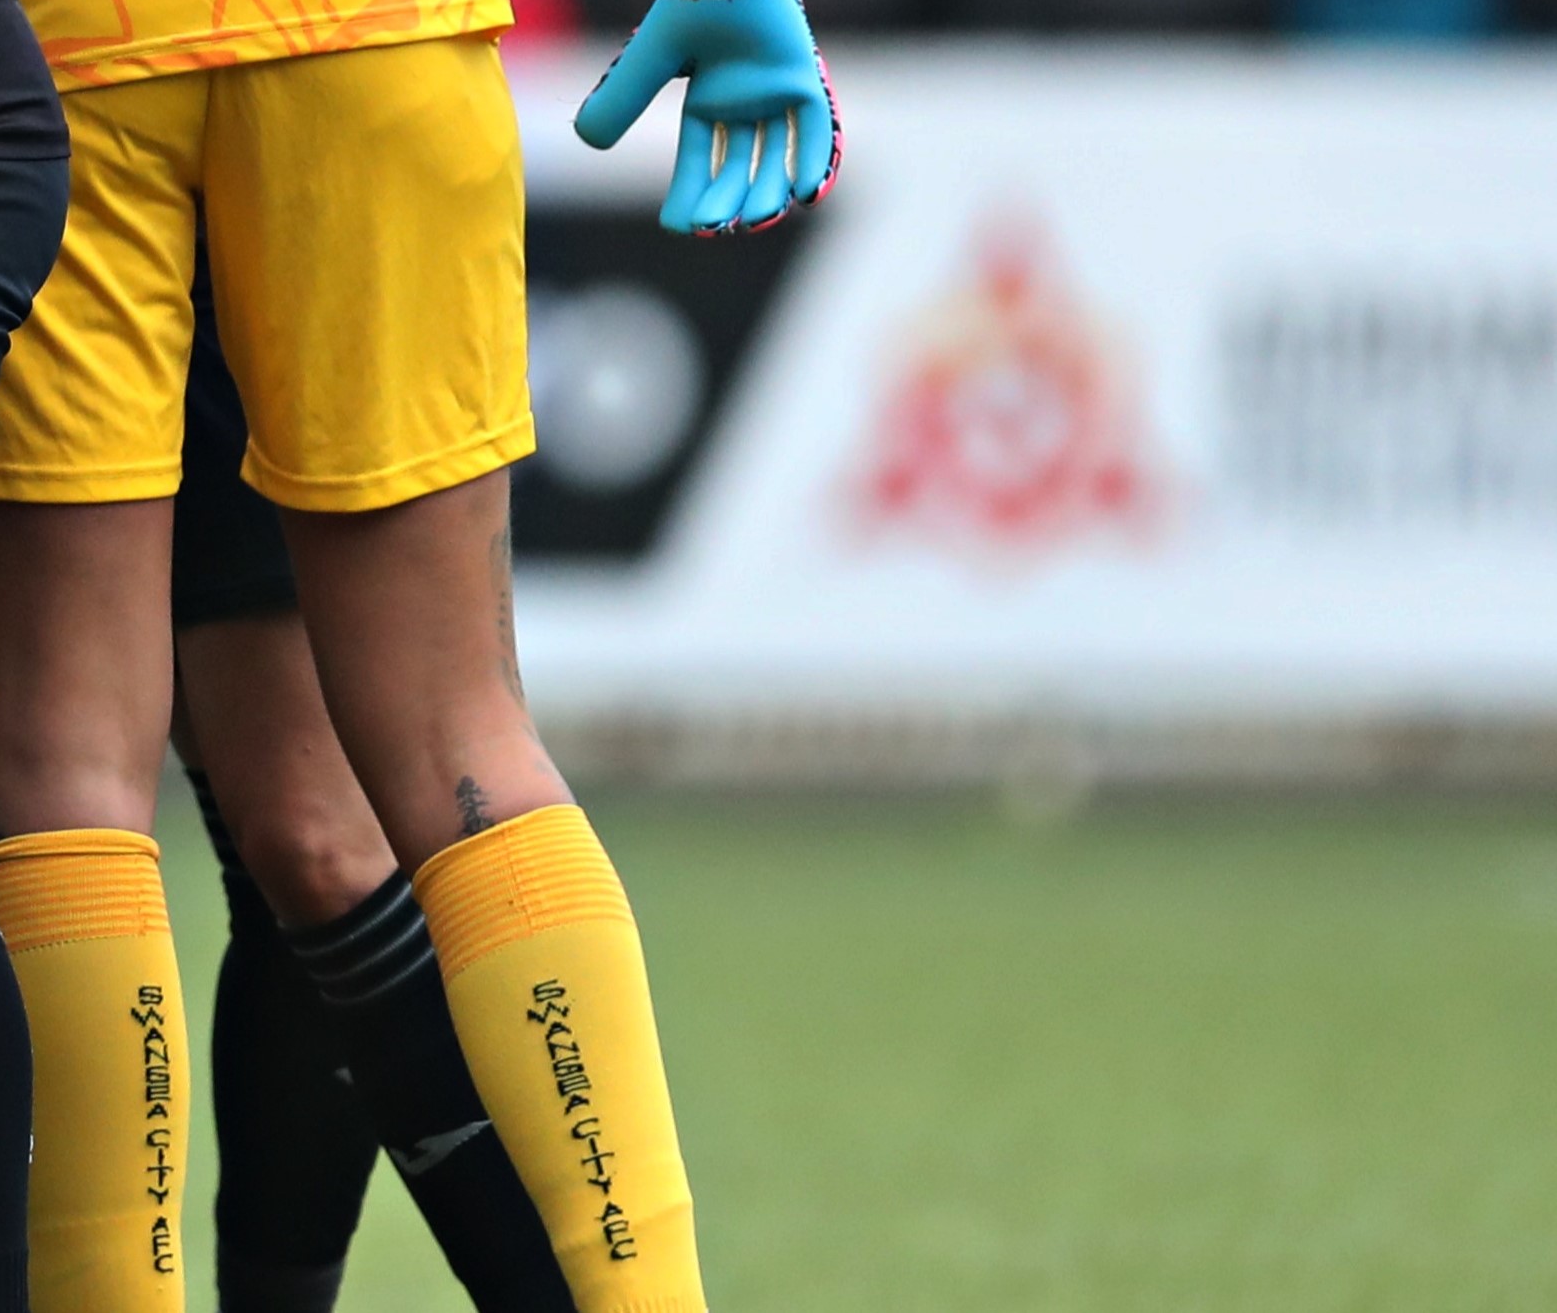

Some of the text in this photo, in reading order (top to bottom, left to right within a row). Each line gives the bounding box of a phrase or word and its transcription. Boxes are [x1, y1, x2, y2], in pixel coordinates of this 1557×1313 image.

[130, 985, 174, 1274] SWANSEA CITY AFC
[527, 980, 637, 1261] SWANSEA CITY AFC
